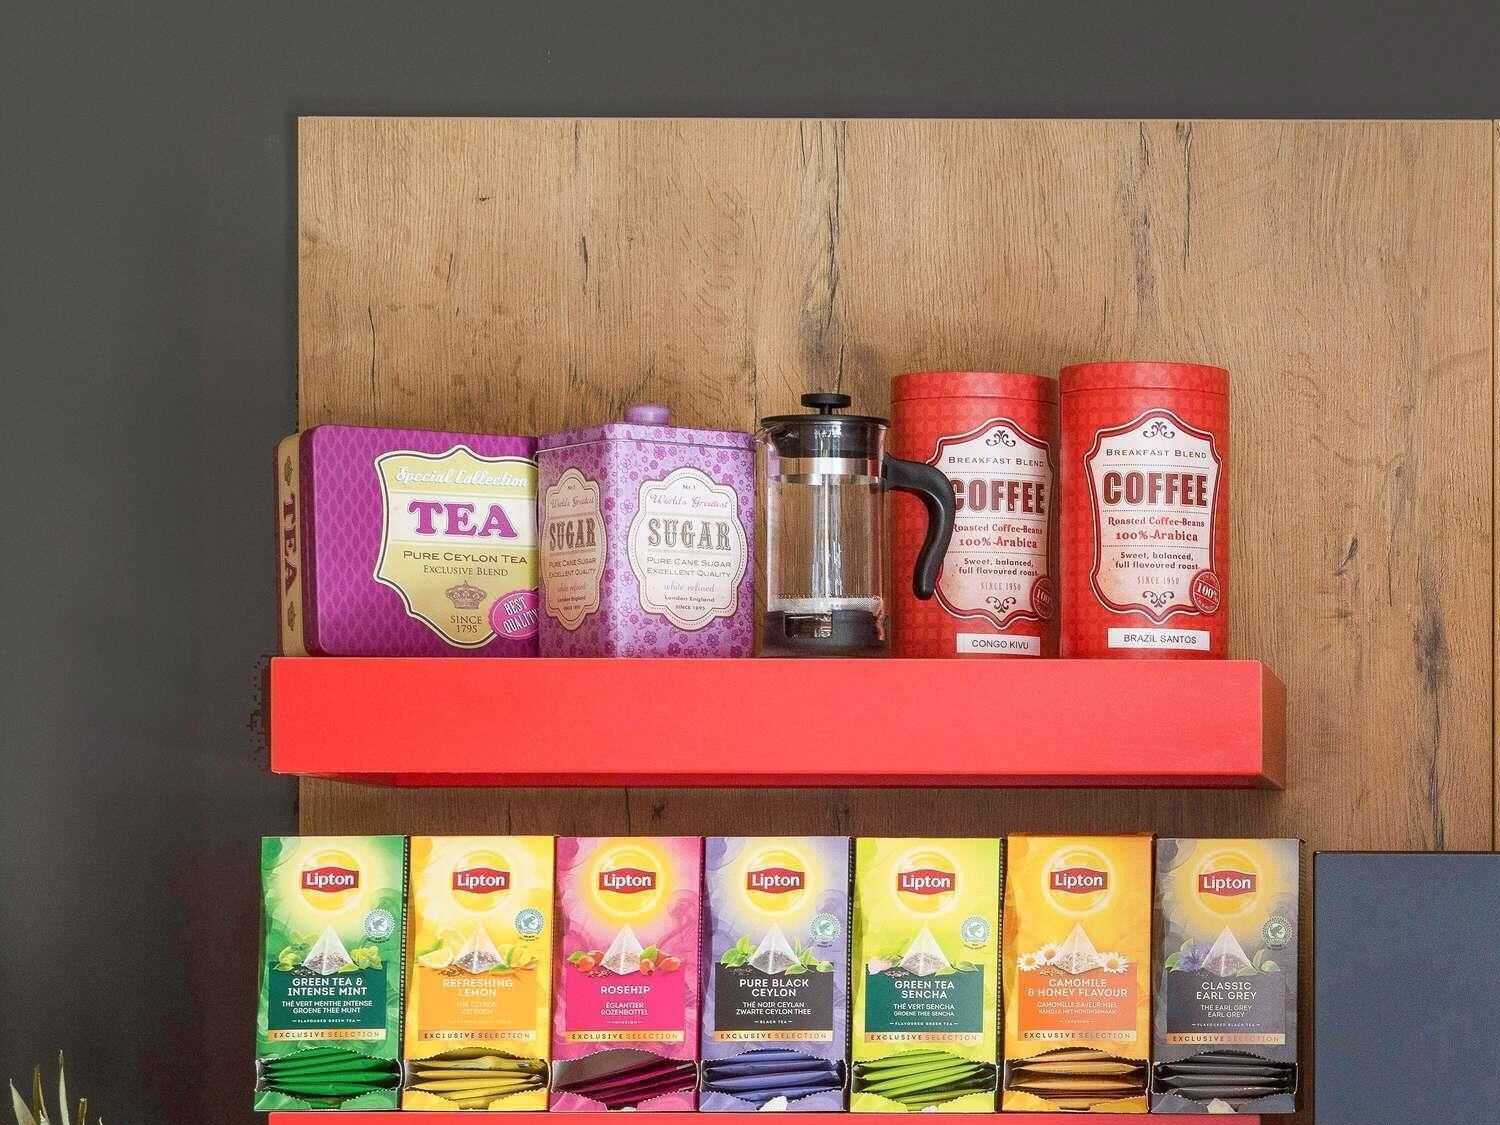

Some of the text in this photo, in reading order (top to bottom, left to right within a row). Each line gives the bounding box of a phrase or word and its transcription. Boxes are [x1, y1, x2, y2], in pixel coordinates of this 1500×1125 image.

[1106, 448, 1207, 459] BREAKFAST BLEND
[948, 456, 1044, 467] BREAKFAST BLEND
[396, 467, 529, 487] Special Collection
[1103, 471, 1207, 507] COFFEE
[949, 479, 1045, 514] COFFEE
[408, 500, 518, 538] TEA
[1108, 517, 1146, 527] Roasted
[953, 523, 989, 533] Roasted
[549, 518, 596, 551] SUGAR
[647, 518, 732, 551] SUGAR
[403, 550, 528, 564] PURE CEYLON TEA
[647, 556, 732, 568] PURE CANE SUGAR
[1115, 561, 1130, 569] full
[1133, 561, 1175, 569] flavoured
[423, 565, 509, 576] EXCLUSIVE BLEND
[647, 568, 695, 576] EXCELLENT
[959, 566, 973, 574] full
[976, 566, 1017, 576] flavoured
[503, 596, 528, 616] BEST
[450, 615, 483, 624] SINCE
[503, 608, 539, 634] QUALITY
[971, 639, 1029, 649] CONGO KIVU
[1123, 634, 1197, 644] BRAZIL SANTOS
[306, 872, 355, 889] Lipton
[456, 873, 506, 889] Lipton
[603, 873, 652, 889] Lipton
[751, 873, 801, 889] Lipton
[901, 874, 952, 892] Lipton
[1055, 872, 1104, 891] Lipton
[1203, 874, 1252, 892] Lipton
[292, 978, 330, 987] GREEN
[332, 977, 353, 987] TEA
[442, 979, 513, 988] REFRESHING
[739, 978, 809, 988] PURE BLACK
[894, 980, 955, 989] GREEN TEA
[1048, 978, 1107, 988] CAMOMILE
[1201, 981, 1252, 990] CLASSIC
[288, 987, 368, 996] INTENSE MINT
[458, 988, 497, 997] LEMON
[600, 985, 651, 995] ROSEHIP
[751, 988, 797, 997] CEYLON
[901, 990, 948, 999] SENCHA
[1038, 988, 1075, 997] HONEY
[1078, 988, 1128, 998] FLAVOUR
[1196, 991, 1257, 1000] EARL GREY
[273, 1031, 325, 1039] EXCLUSIVE
